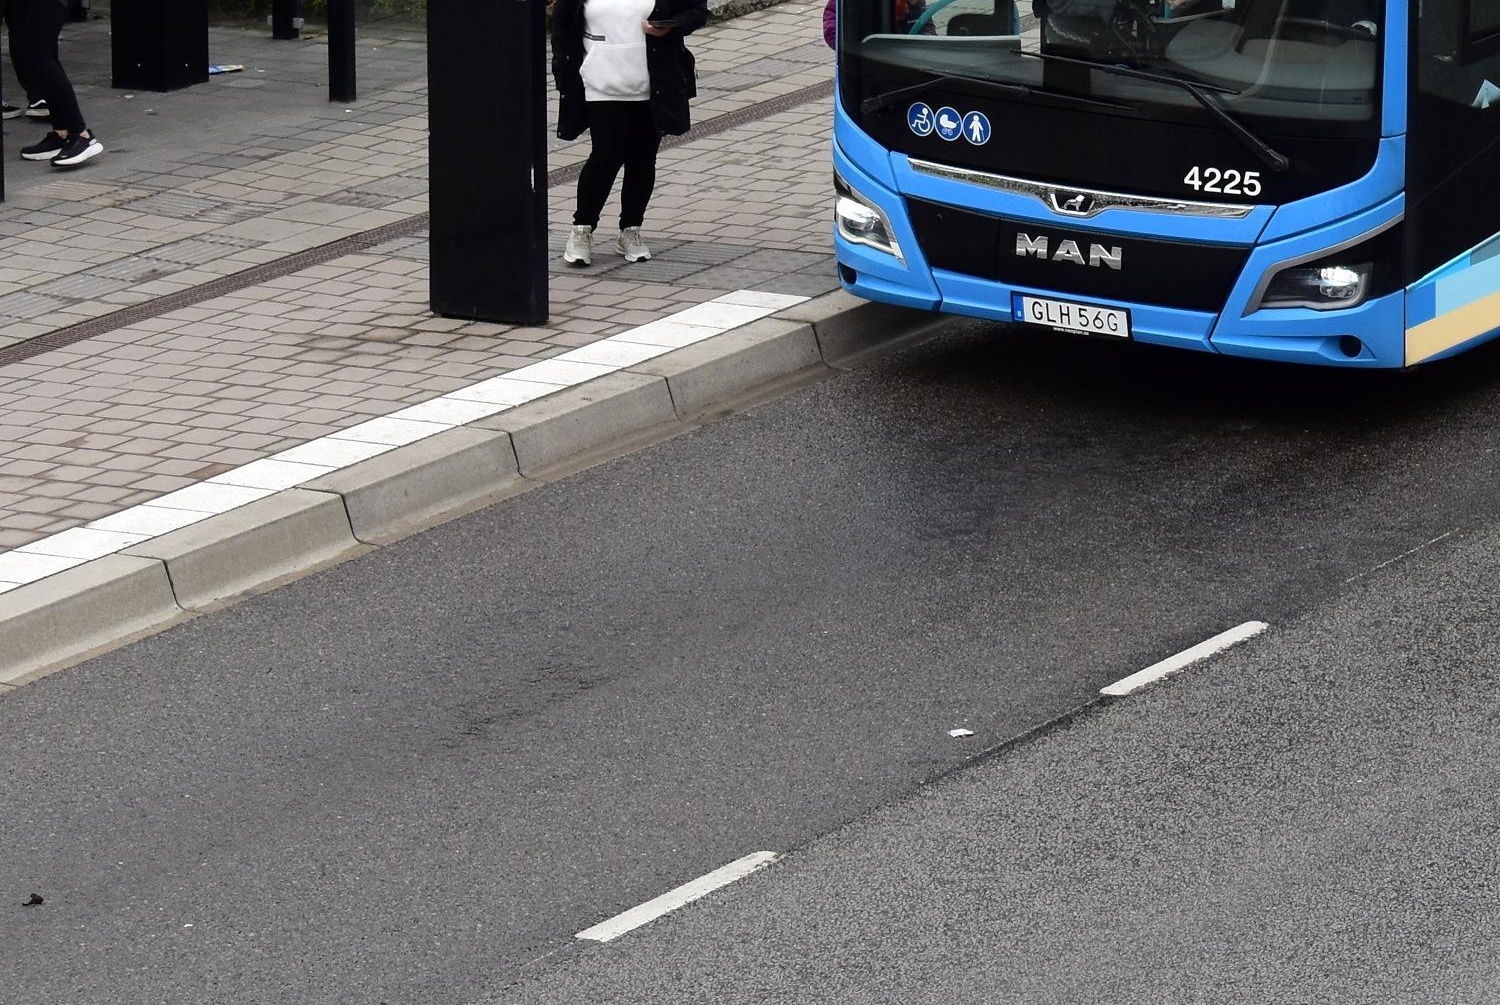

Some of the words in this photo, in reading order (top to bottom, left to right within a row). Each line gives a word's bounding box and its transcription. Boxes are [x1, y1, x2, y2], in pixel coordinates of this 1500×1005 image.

[1184, 166, 1261, 196] 4225
[1015, 232, 1122, 270] MAN
[1032, 301, 1070, 325] GLH
[1078, 307, 1118, 332] 56G
